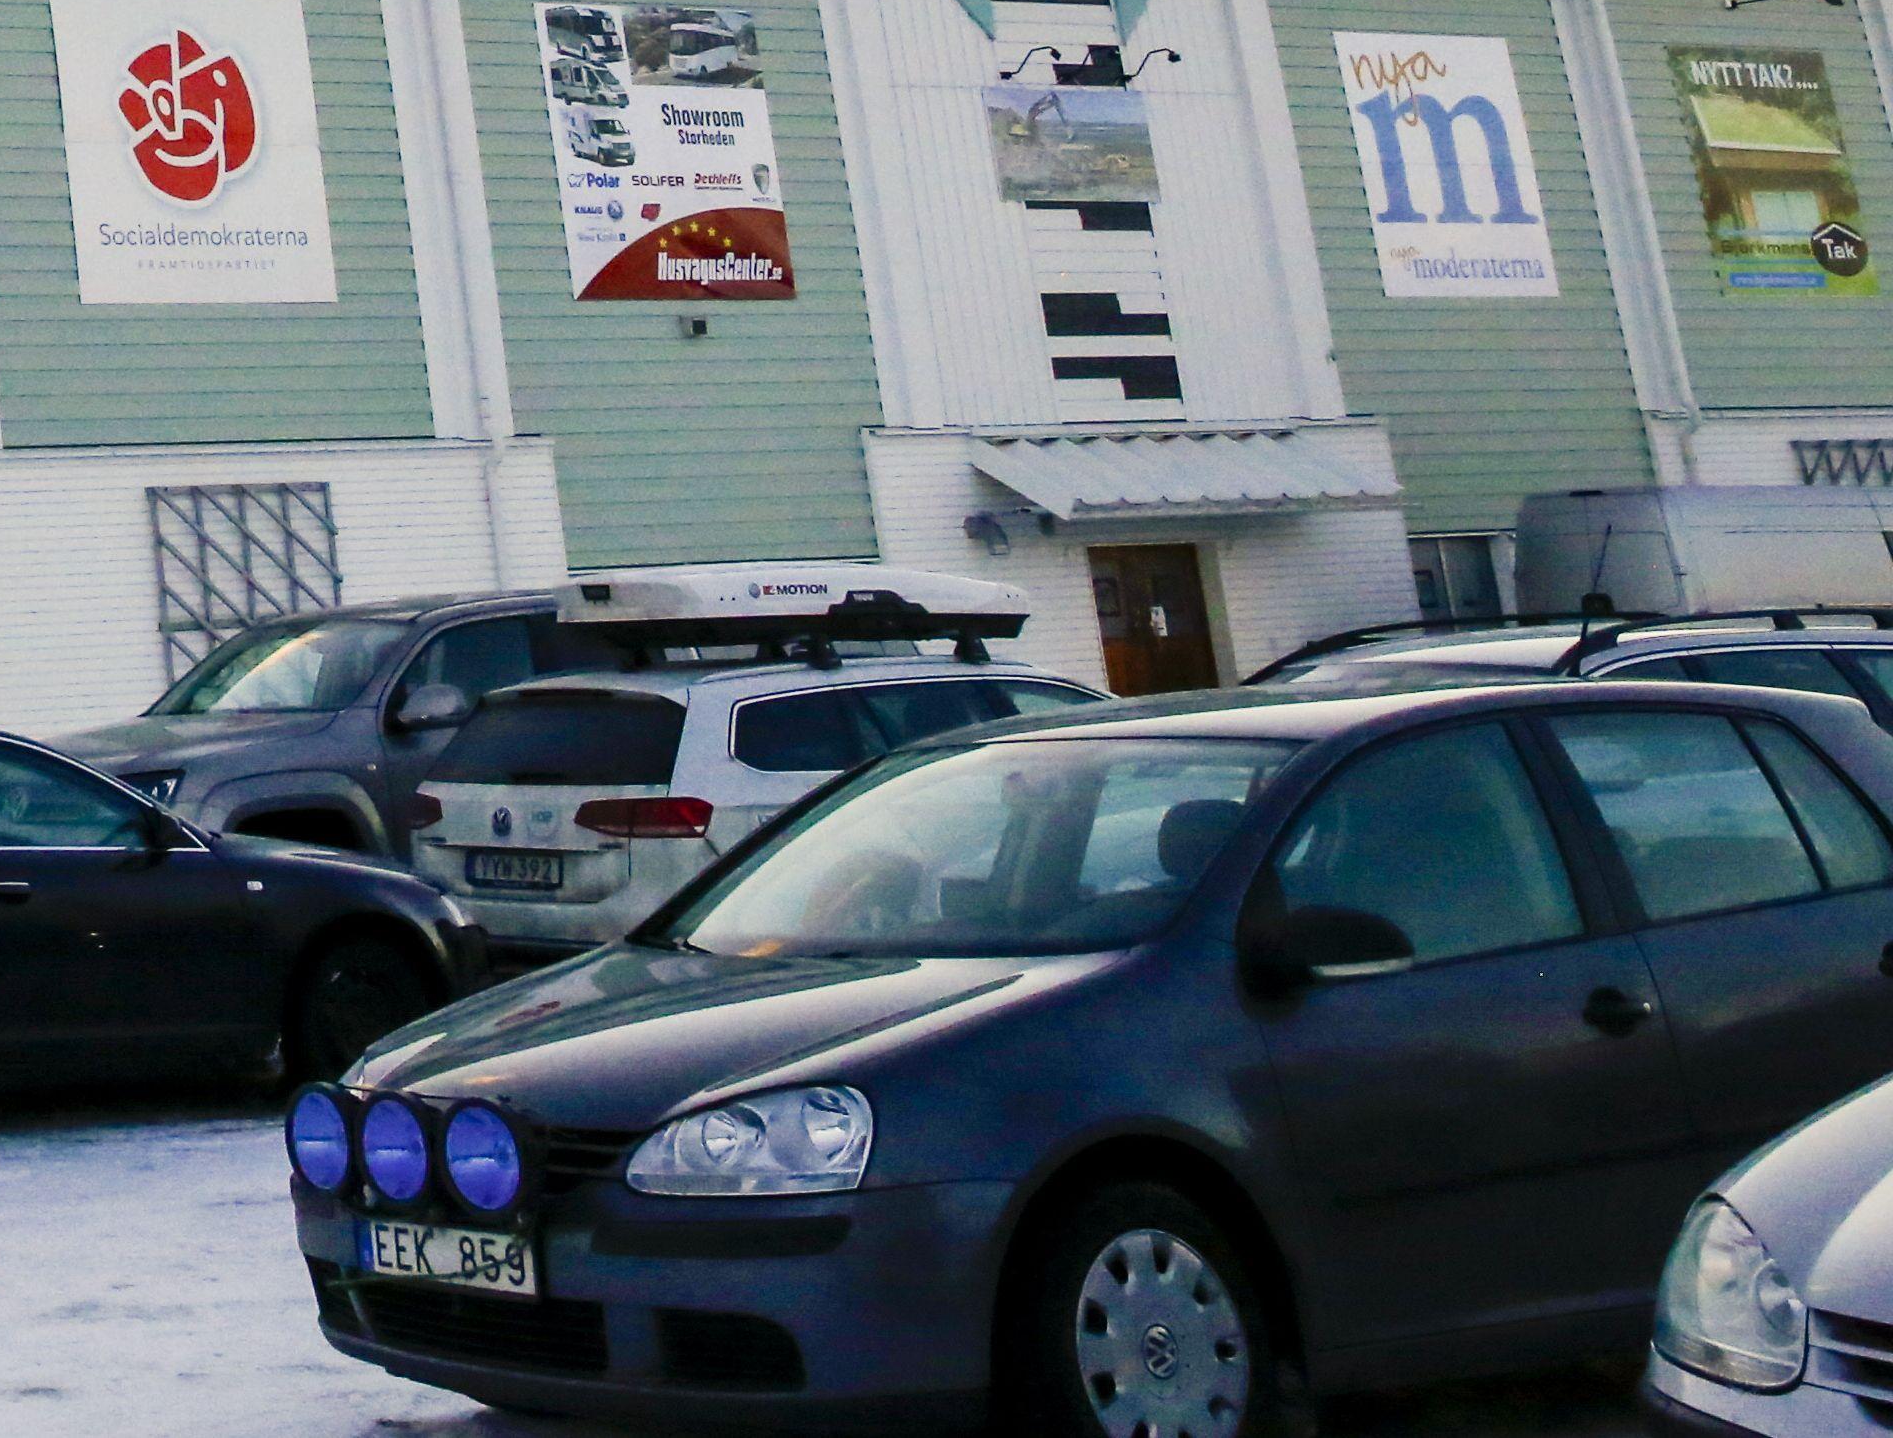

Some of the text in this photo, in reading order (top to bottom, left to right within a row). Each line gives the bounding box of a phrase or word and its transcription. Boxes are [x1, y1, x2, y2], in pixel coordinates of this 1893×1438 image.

[1692, 61, 1743, 86] NYTT
[661, 103, 744, 128] Showroom
[678, 130, 735, 146] Storheden
[1357, 89, 1540, 224] m
[586, 172, 620, 187] Polar
[631, 175, 685, 187] SOLIFER
[99, 223, 308, 247] Socialdemokraterna
[1822, 238, 1858, 259] Tak
[1414, 247, 1545, 278] moderaterna
[374, 1223, 526, 1286] EEK 859
